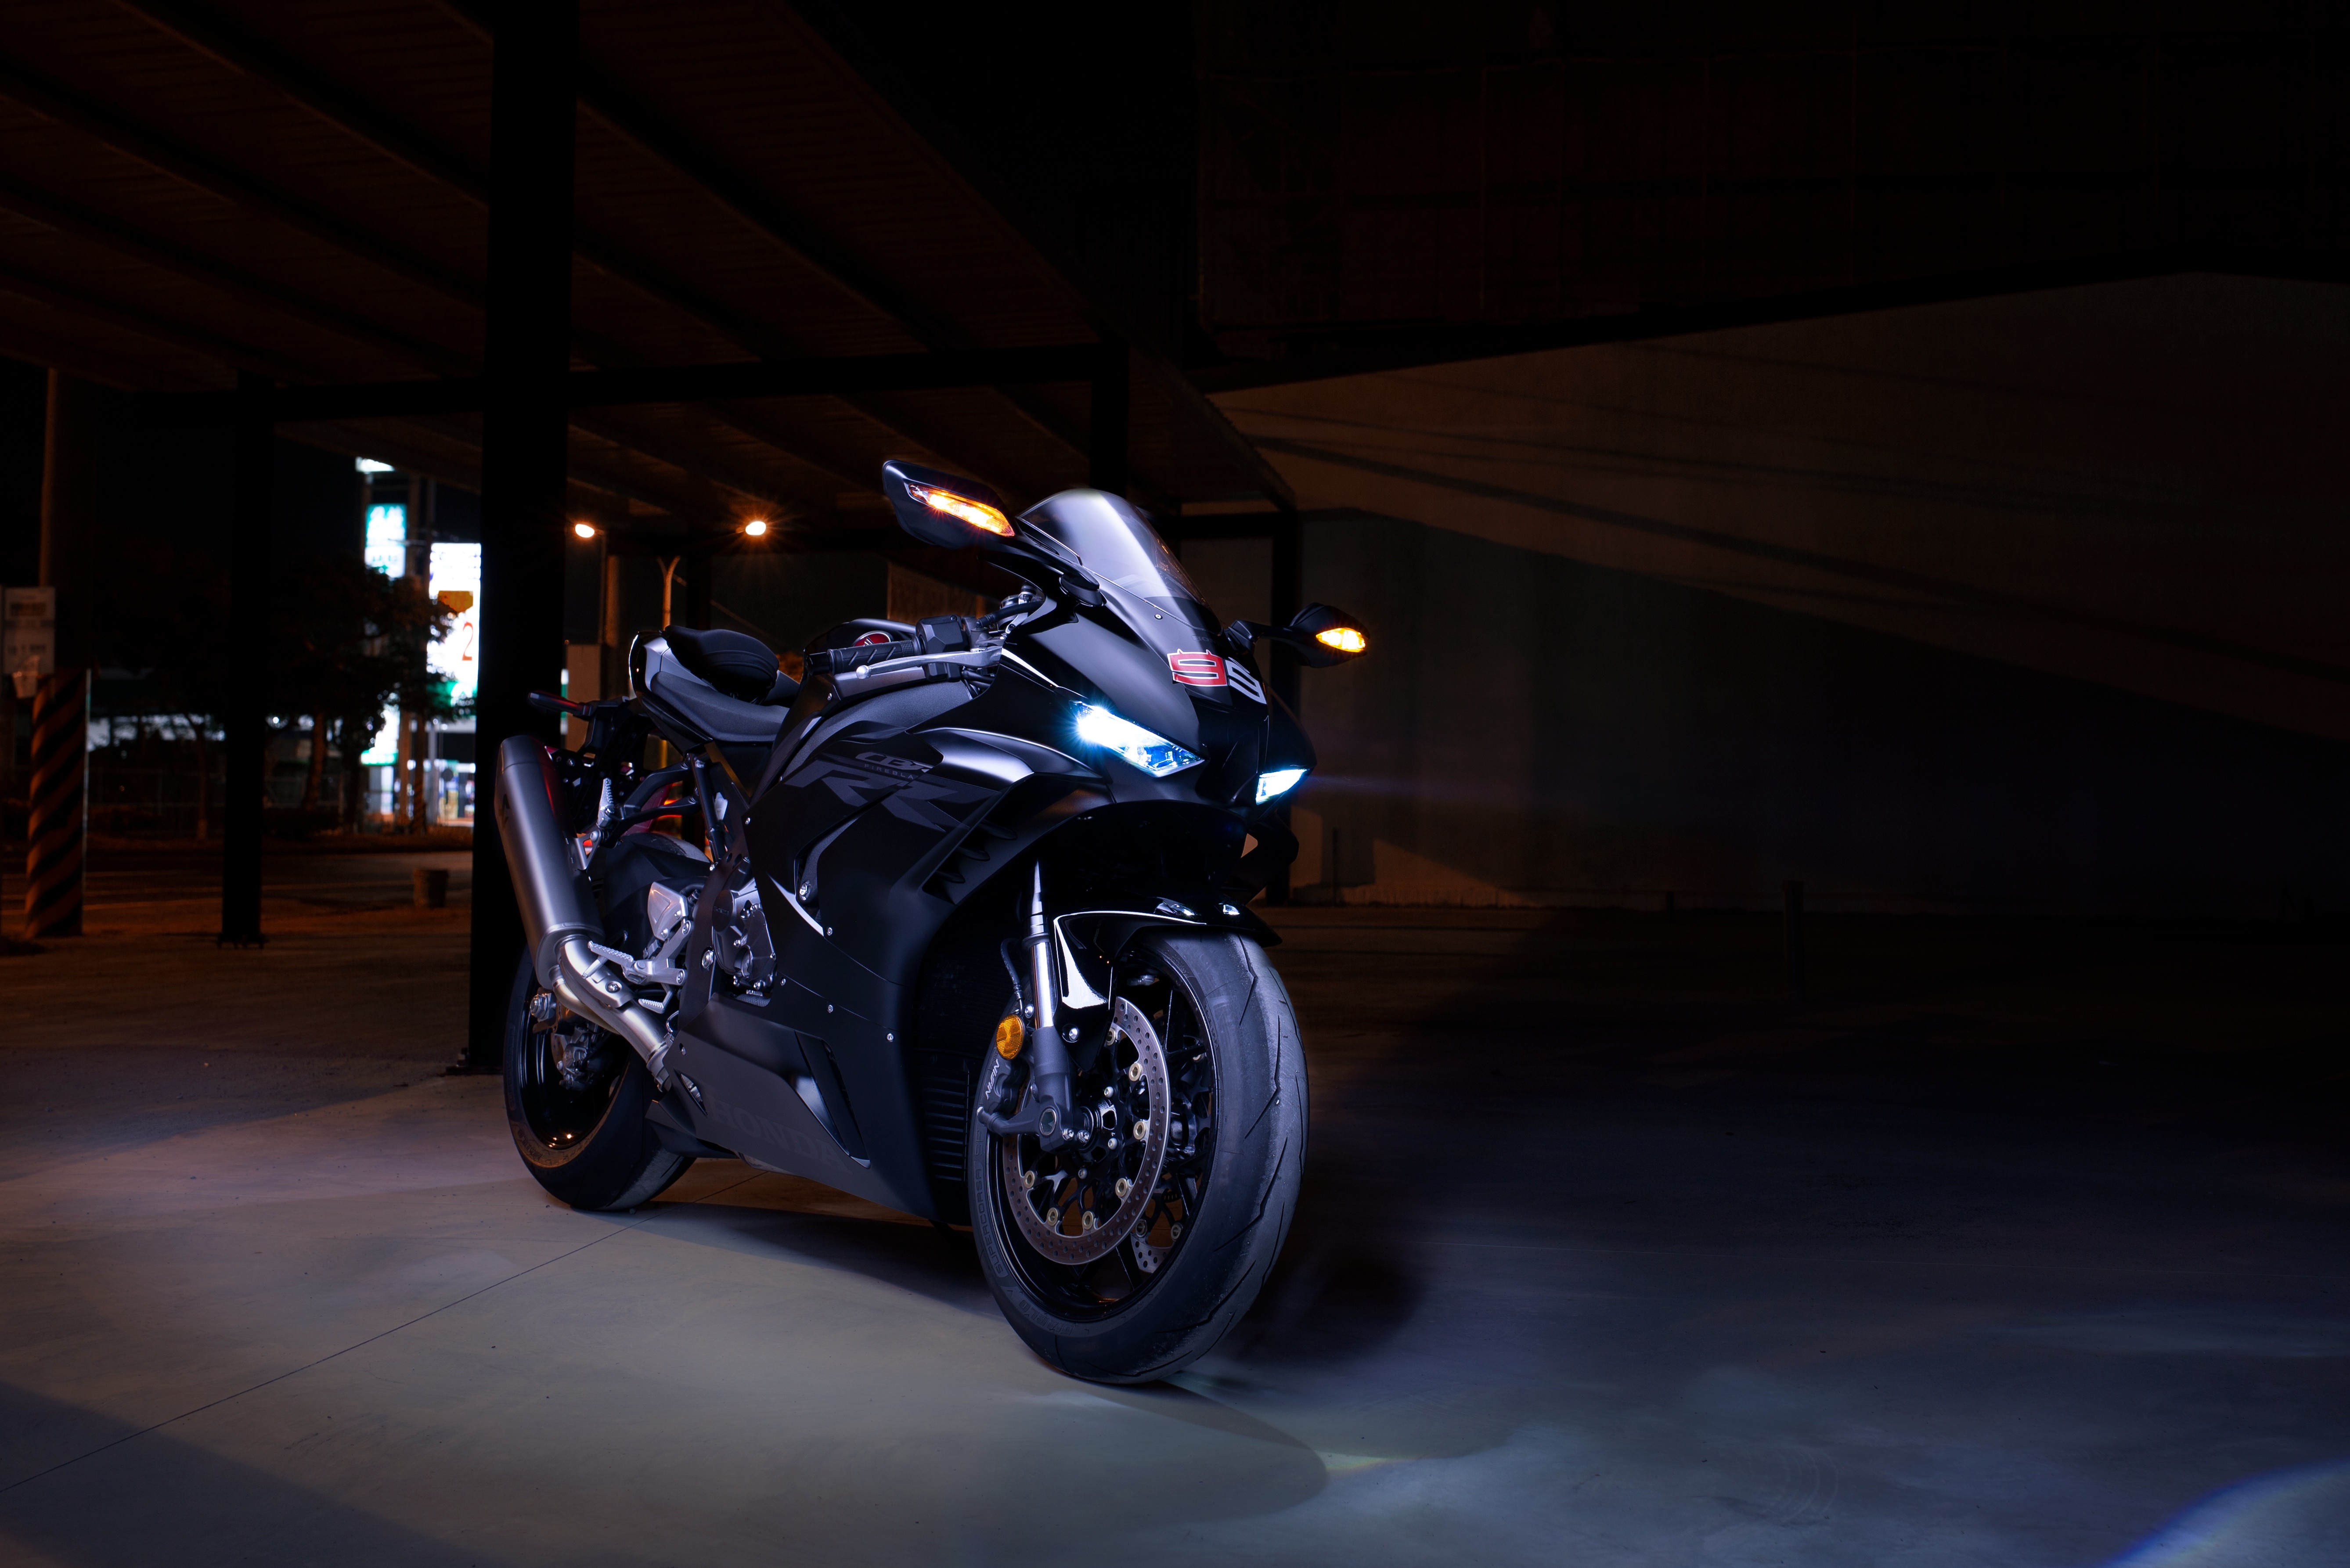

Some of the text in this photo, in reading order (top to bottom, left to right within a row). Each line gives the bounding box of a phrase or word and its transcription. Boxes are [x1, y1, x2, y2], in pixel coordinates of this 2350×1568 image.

[985, 1058, 999, 1100] NISSIN
[709, 1098, 854, 1175] HONDA
[975, 1130, 1003, 1277] SUPERCORSA SP
[1019, 1299, 1075, 1335] DIABLO
